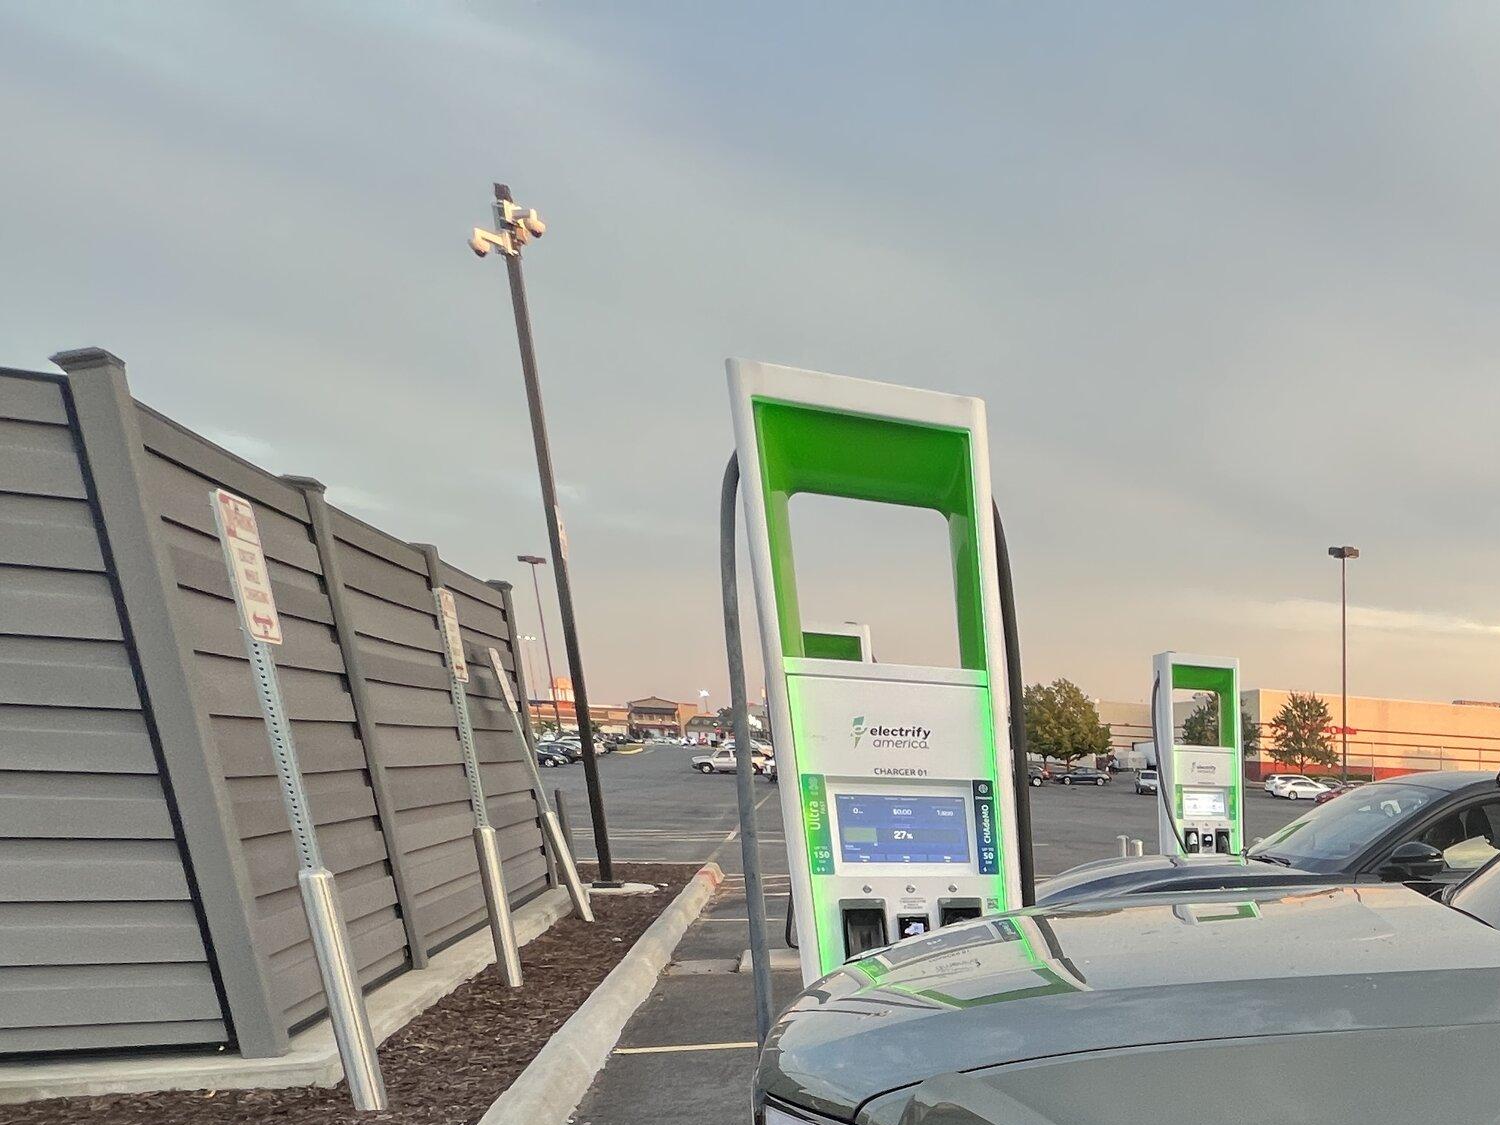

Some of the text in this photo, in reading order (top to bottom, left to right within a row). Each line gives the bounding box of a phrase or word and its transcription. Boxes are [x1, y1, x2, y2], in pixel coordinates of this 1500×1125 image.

[870, 725, 931, 740] electrify
[873, 739, 928, 749] america
[874, 767, 928, 777] CHARGER 01
[808, 800, 821, 831] Ultra
[981, 804, 992, 844] CHAdeMO
[814, 851, 830, 859] 150
[983, 851, 994, 860] 50
